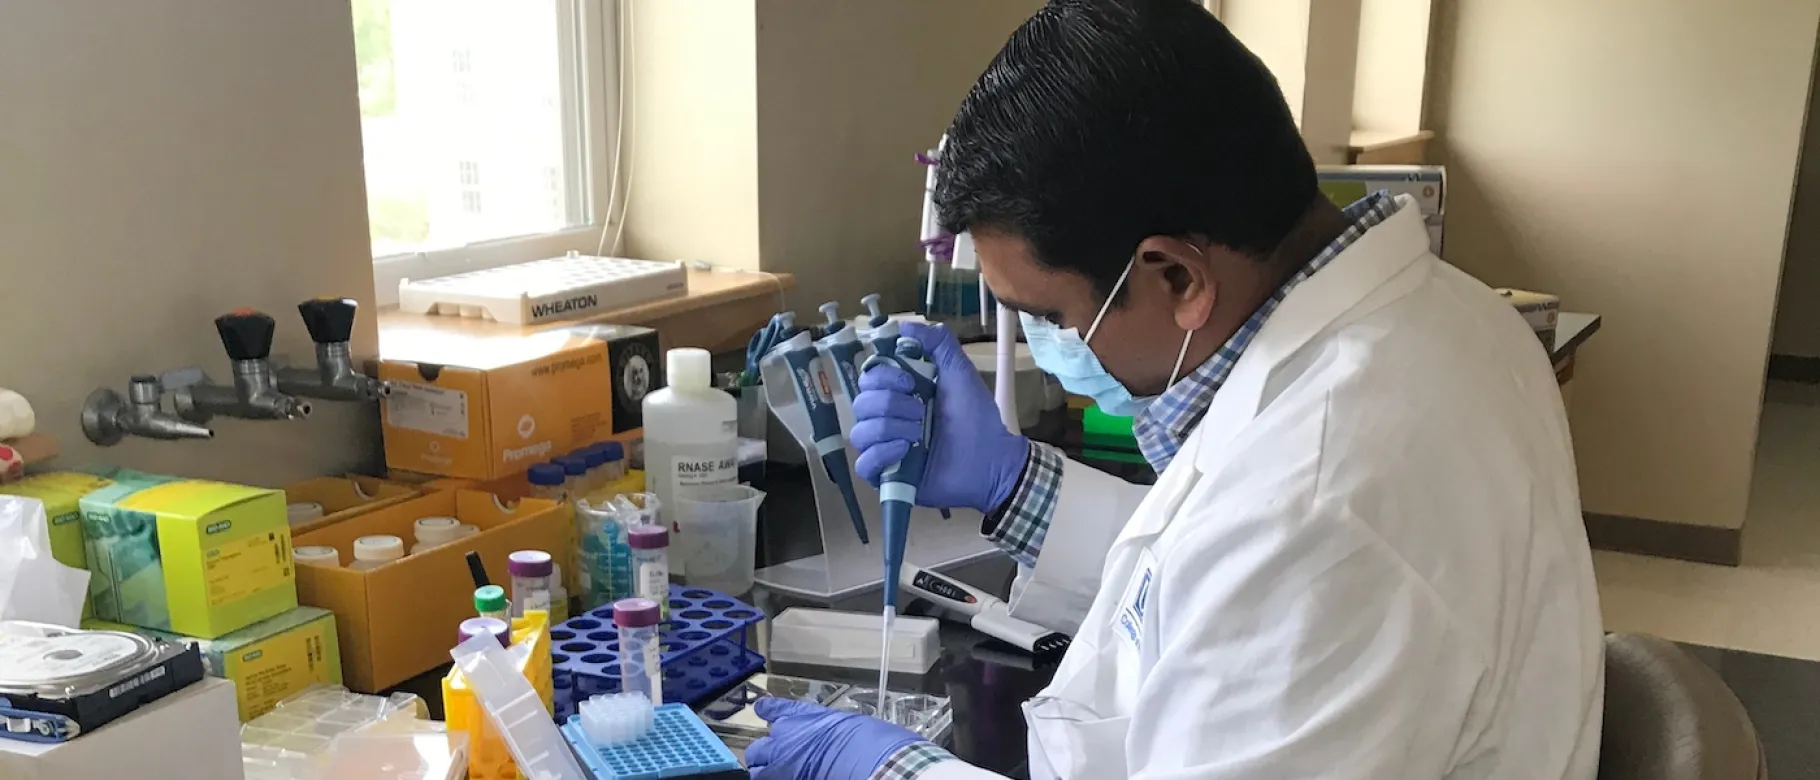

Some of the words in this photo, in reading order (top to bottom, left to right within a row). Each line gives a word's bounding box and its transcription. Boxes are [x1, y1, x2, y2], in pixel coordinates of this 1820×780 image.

[532, 294, 598, 318] WHEATON
[503, 440, 552, 463] Promega
[678, 461, 714, 473] RNASE
